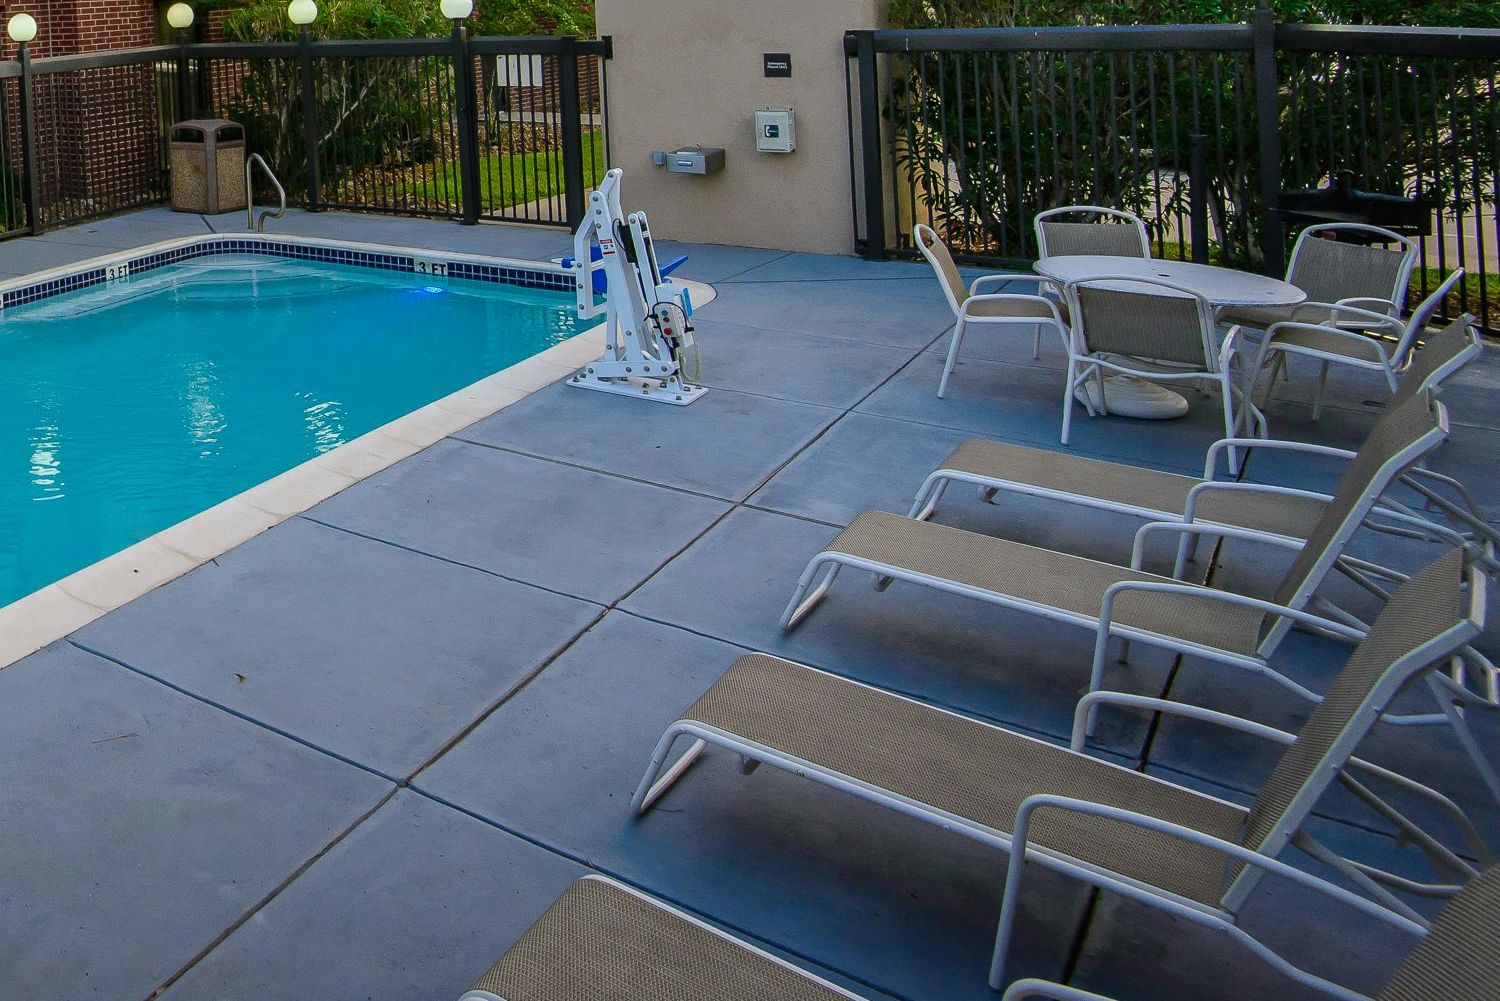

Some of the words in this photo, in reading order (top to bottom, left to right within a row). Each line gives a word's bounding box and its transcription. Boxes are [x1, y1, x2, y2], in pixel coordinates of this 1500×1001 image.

[109, 268, 116, 280] 3
[118, 264, 128, 278] FT
[419, 261, 427, 274] 3
[431, 262, 447, 275] FT
